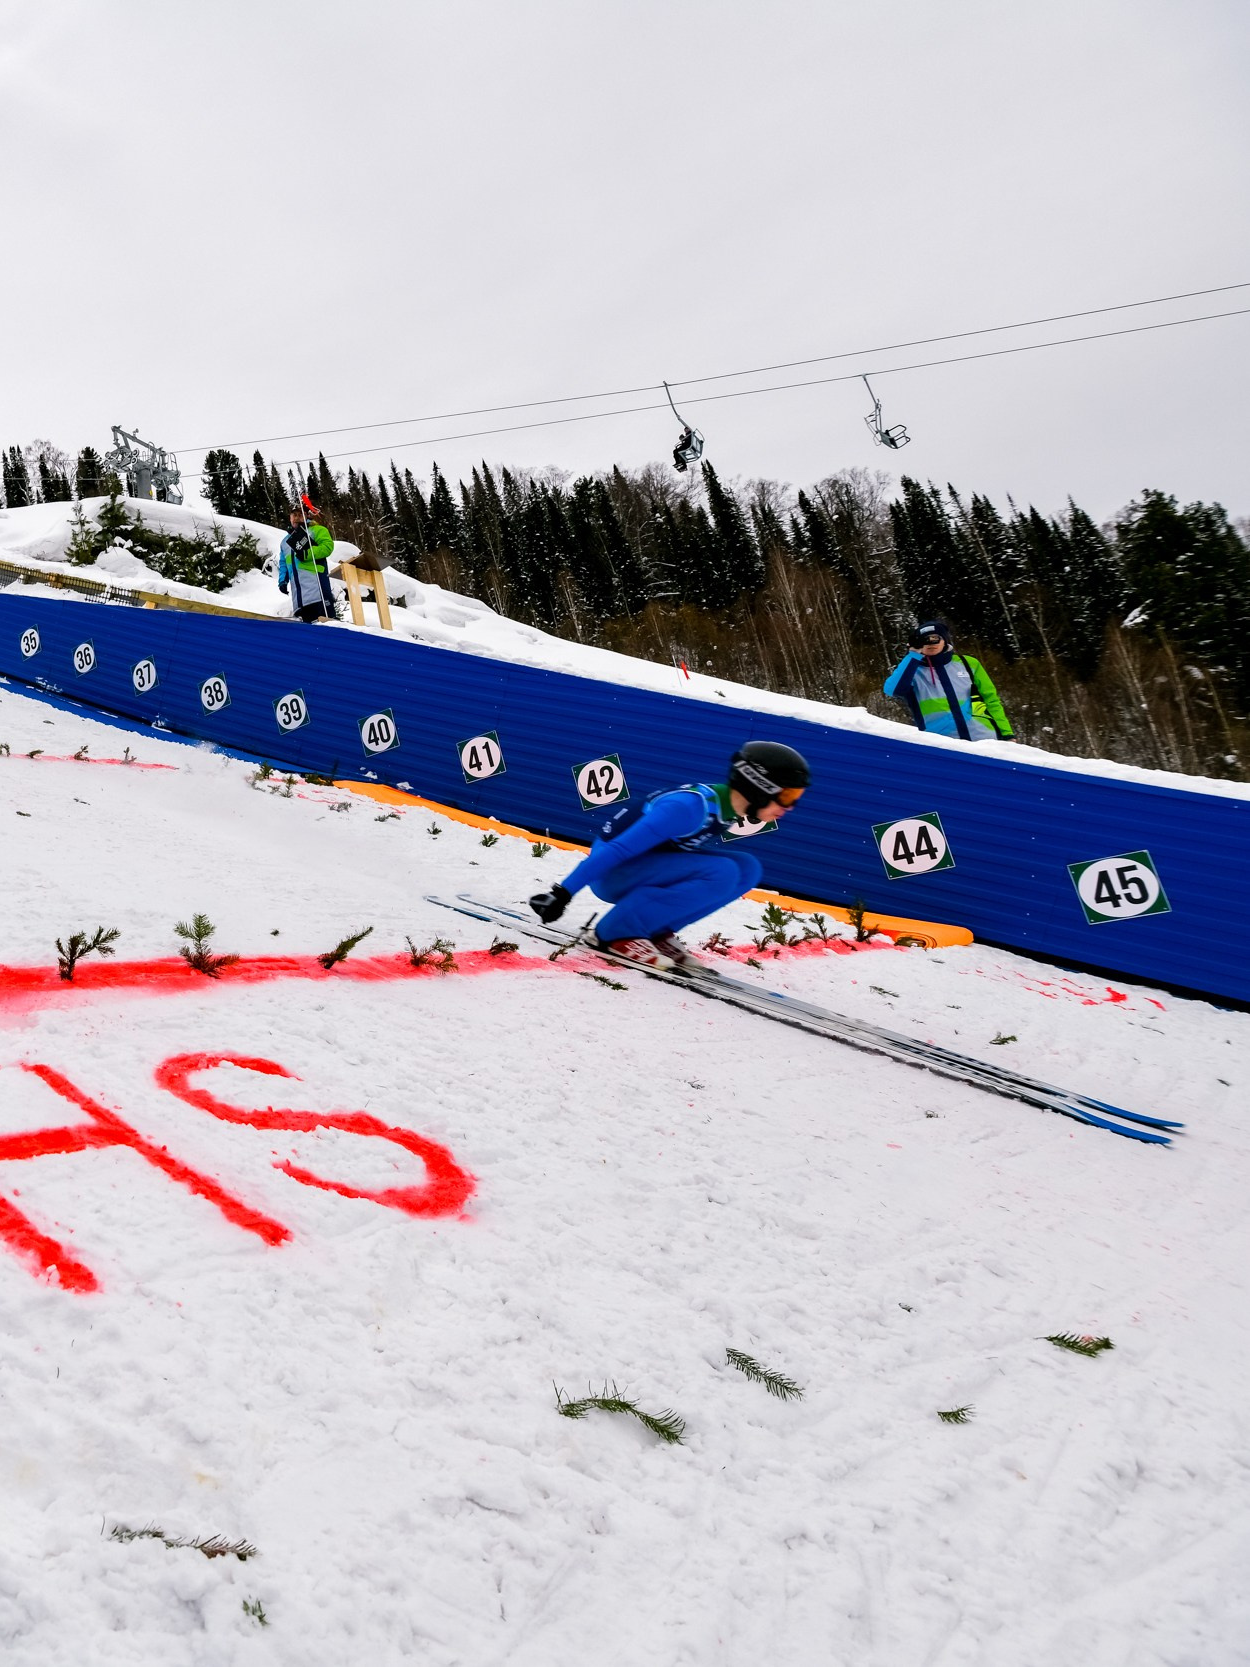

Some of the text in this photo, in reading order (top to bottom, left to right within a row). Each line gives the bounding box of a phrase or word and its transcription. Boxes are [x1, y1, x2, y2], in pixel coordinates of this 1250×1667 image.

[22, 632, 37, 654] 35
[76, 647, 92, 670] 36
[136, 663, 152, 688] 37
[204, 680, 225, 707] 38
[280, 697, 303, 726] 39
[367, 718, 392, 746] 40
[468, 741, 496, 772] 41
[586, 765, 619, 798] 42
[892, 825, 938, 865] 44
[1094, 864, 1150, 908] 45
